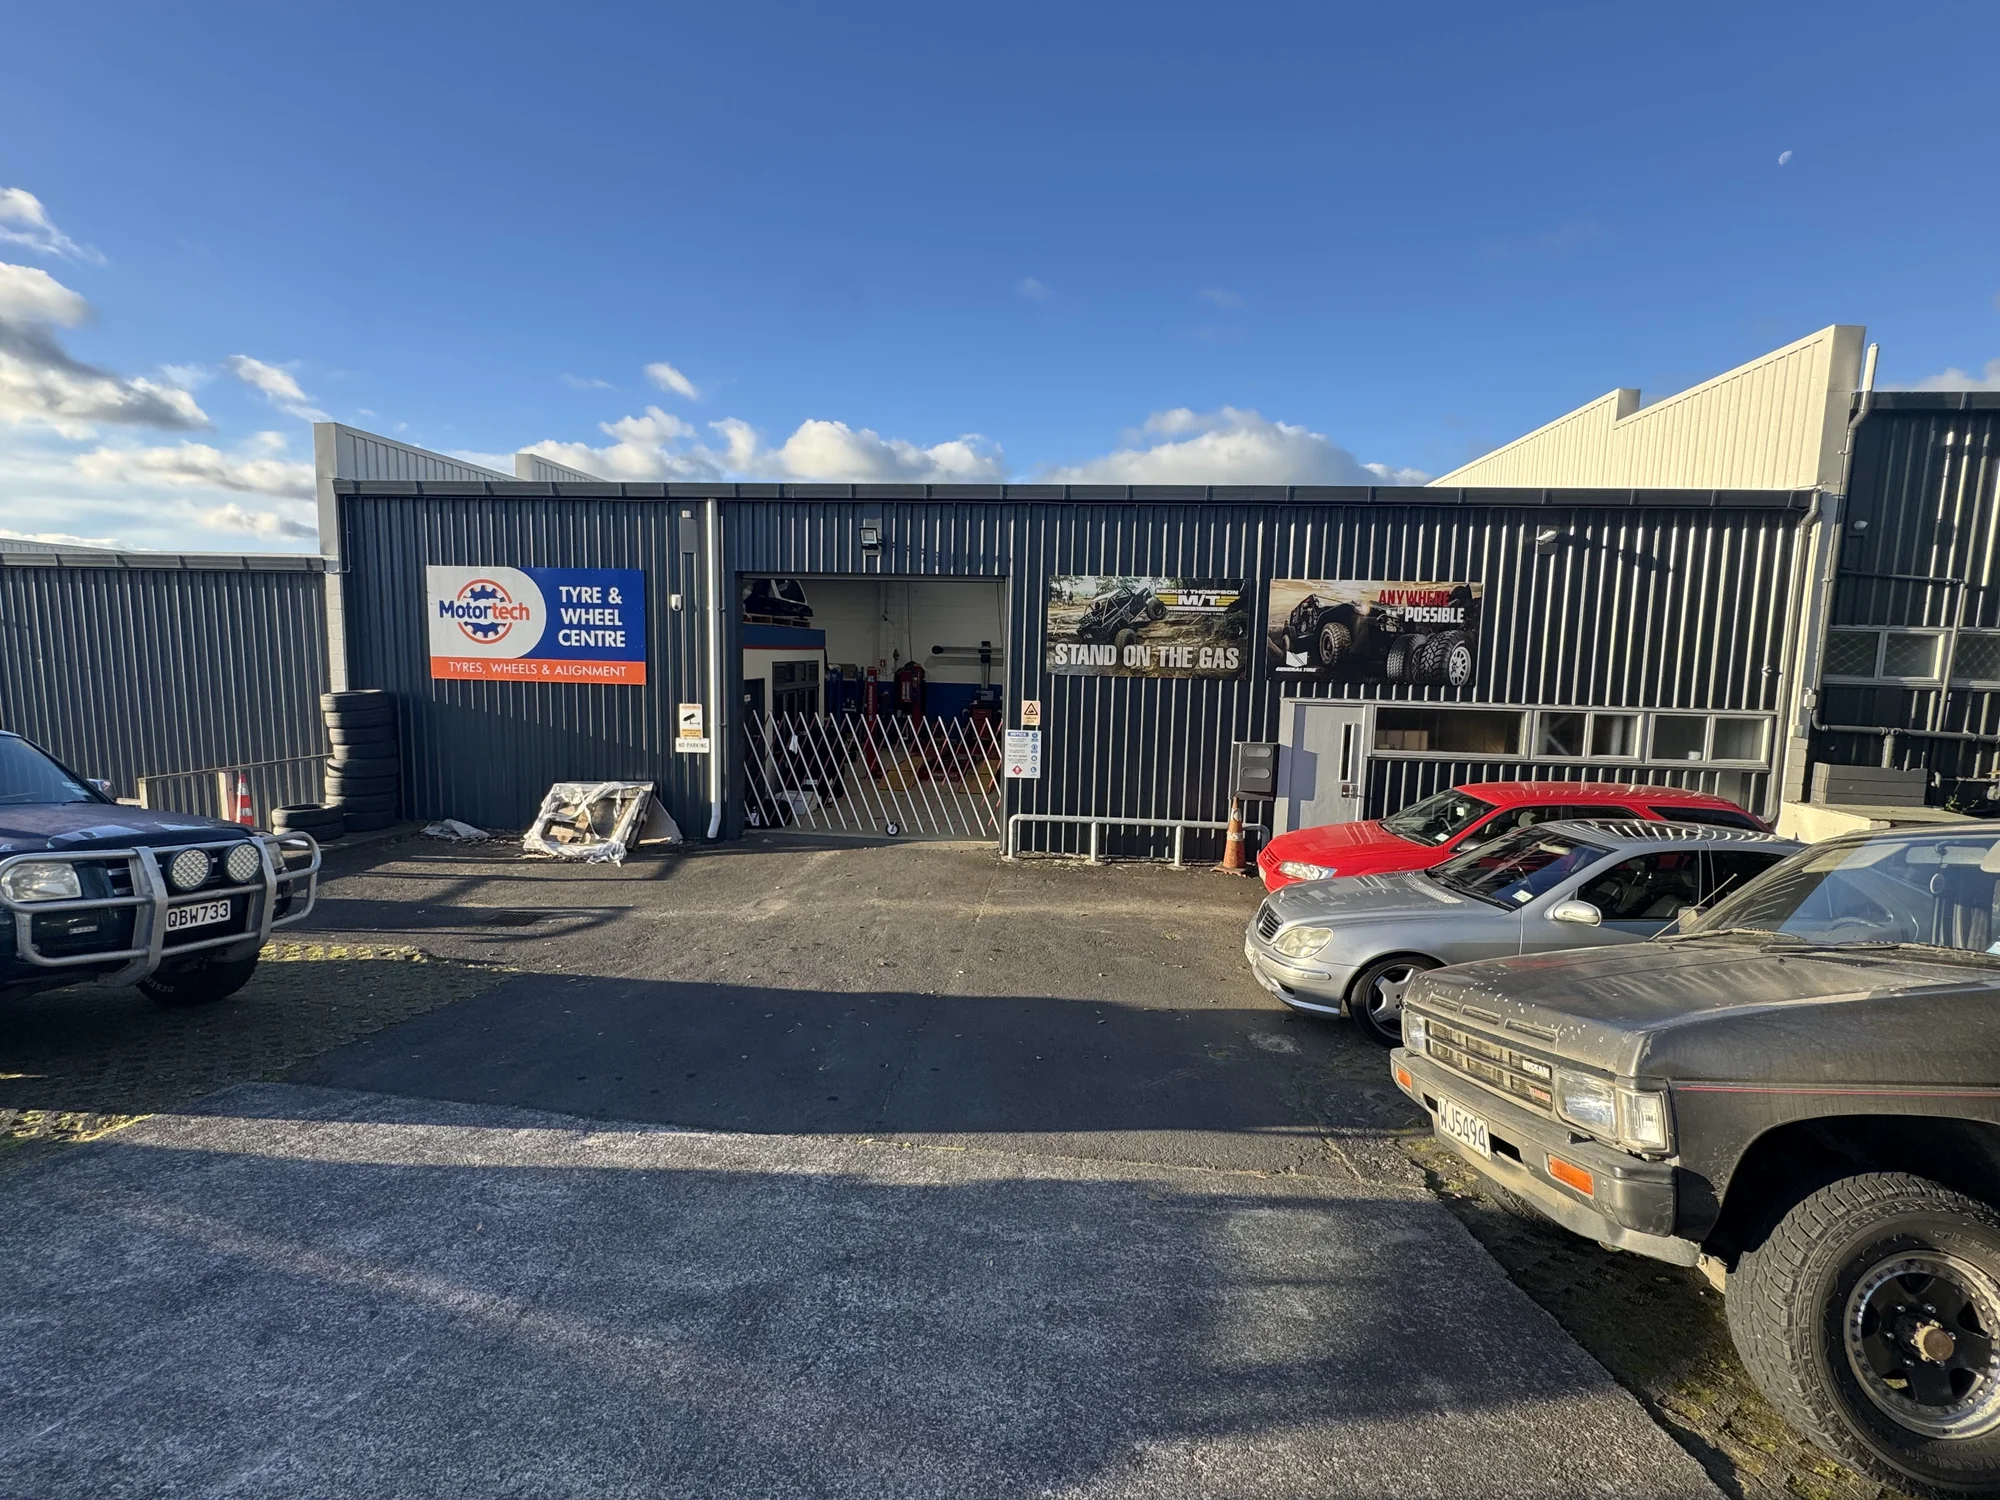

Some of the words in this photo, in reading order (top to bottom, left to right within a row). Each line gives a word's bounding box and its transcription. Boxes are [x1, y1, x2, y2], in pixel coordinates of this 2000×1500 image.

[559, 586, 601, 604] TYRE
[607, 587, 623, 605] &
[1177, 594, 1221, 607] M/T
[1378, 589, 1450, 607] ANYWHERE
[439, 600, 530, 621] Motortech
[560, 608, 623, 626] WHEEL
[1404, 606, 1465, 623] POSSIBLE
[558, 629, 626, 648] CENTRE
[1054, 643, 1117, 666] STAND
[1123, 644, 1150, 667] ON
[1157, 645, 1193, 668] THE
[1199, 647, 1239, 670] GAS
[448, 661, 486, 675] TYRES,
[490, 662, 537, 675] WHEELS
[541, 664, 551, 676] &
[554, 665, 627, 678] ALIGNMENT
[167, 902, 229, 928] QBW733
[1522, 1059, 1551, 1080] NISSAN
[1439, 1100, 1487, 1153] WJ5494
